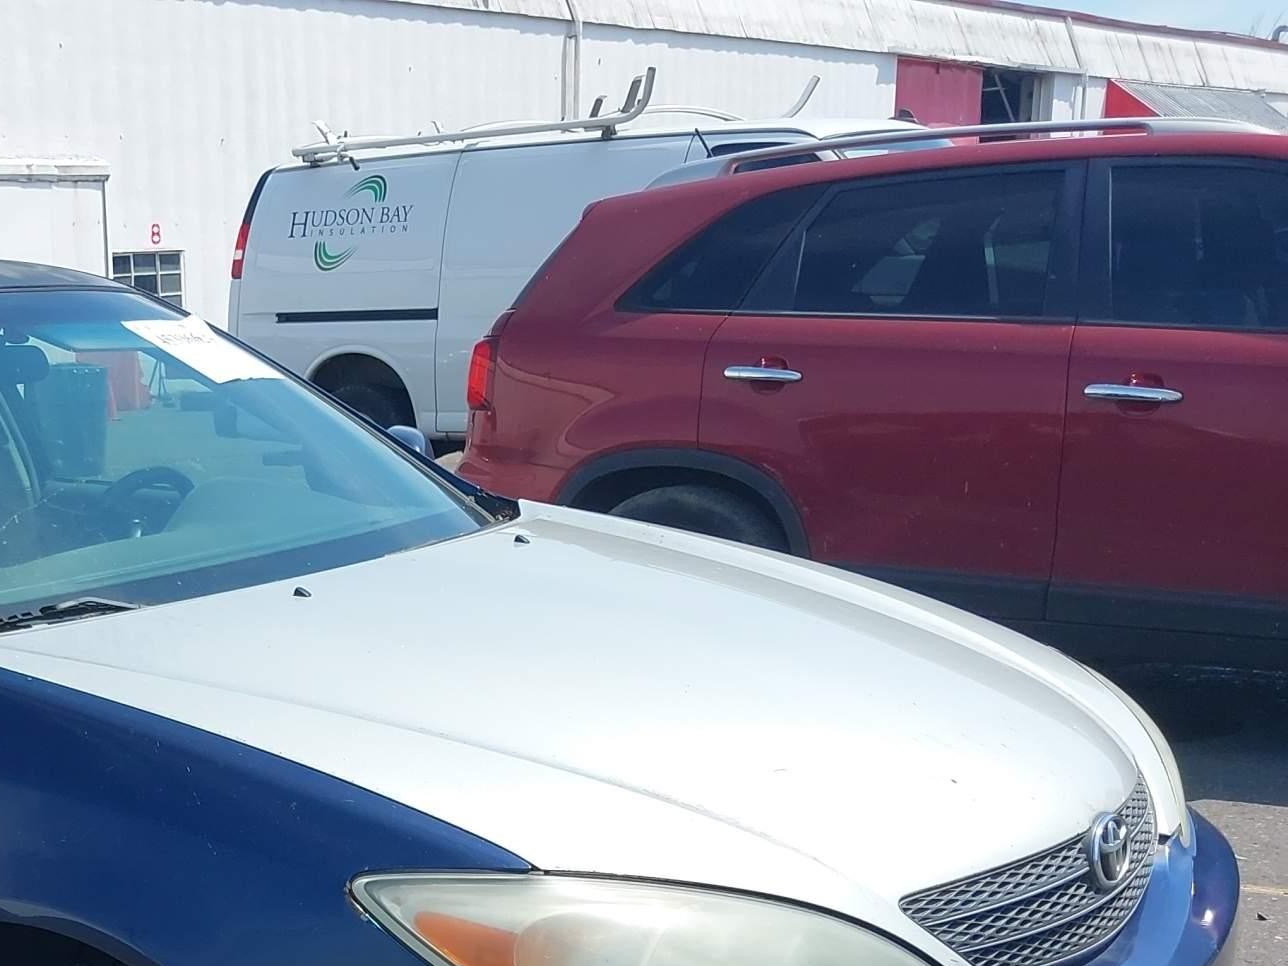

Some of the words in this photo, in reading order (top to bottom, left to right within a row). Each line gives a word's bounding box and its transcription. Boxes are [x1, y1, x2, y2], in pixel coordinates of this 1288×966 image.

[288, 207, 374, 239] HUDSON
[379, 205, 412, 224] BAY
[310, 224, 410, 238] INSULATION
[151, 223, 162, 245] 8
